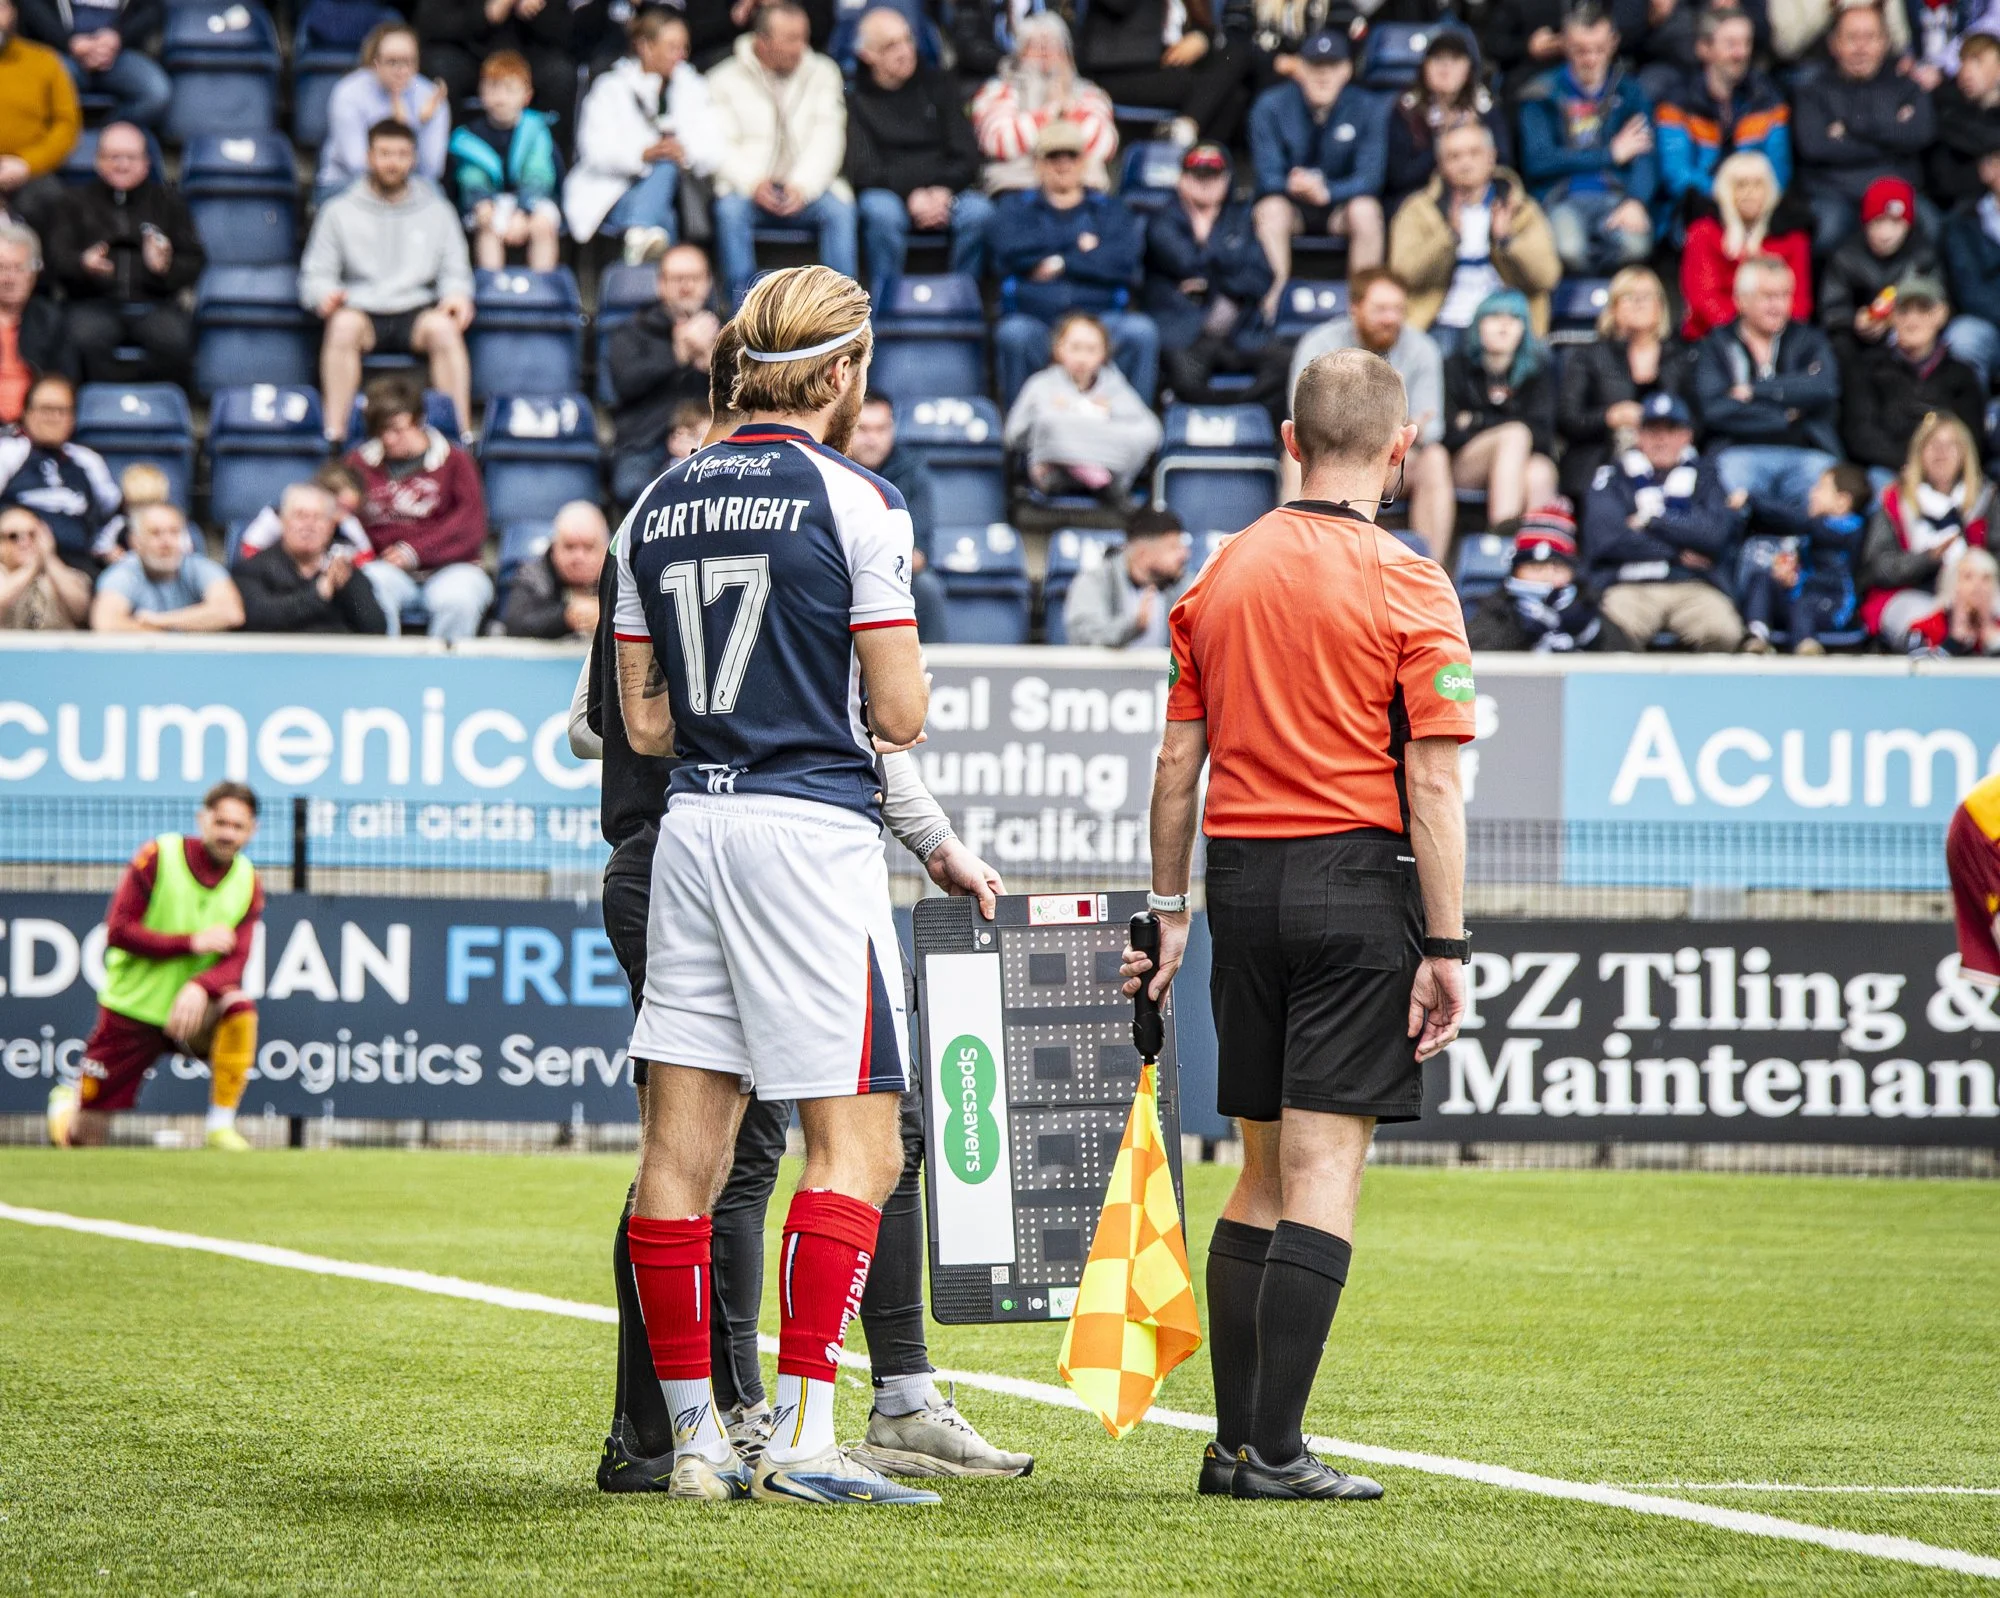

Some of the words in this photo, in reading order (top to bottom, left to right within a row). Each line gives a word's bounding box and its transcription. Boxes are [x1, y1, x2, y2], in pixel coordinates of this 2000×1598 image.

[643, 496, 811, 543] CARTWRIGHT
[661, 554, 771, 715] 17
[1609, 704, 2000, 809] Acum
[416, 797, 536, 842] adds
[1599, 946, 1906, 1053] Tiling
[243, 1029, 483, 1095] ogistics
[956, 1046, 981, 1173] Specsavers
